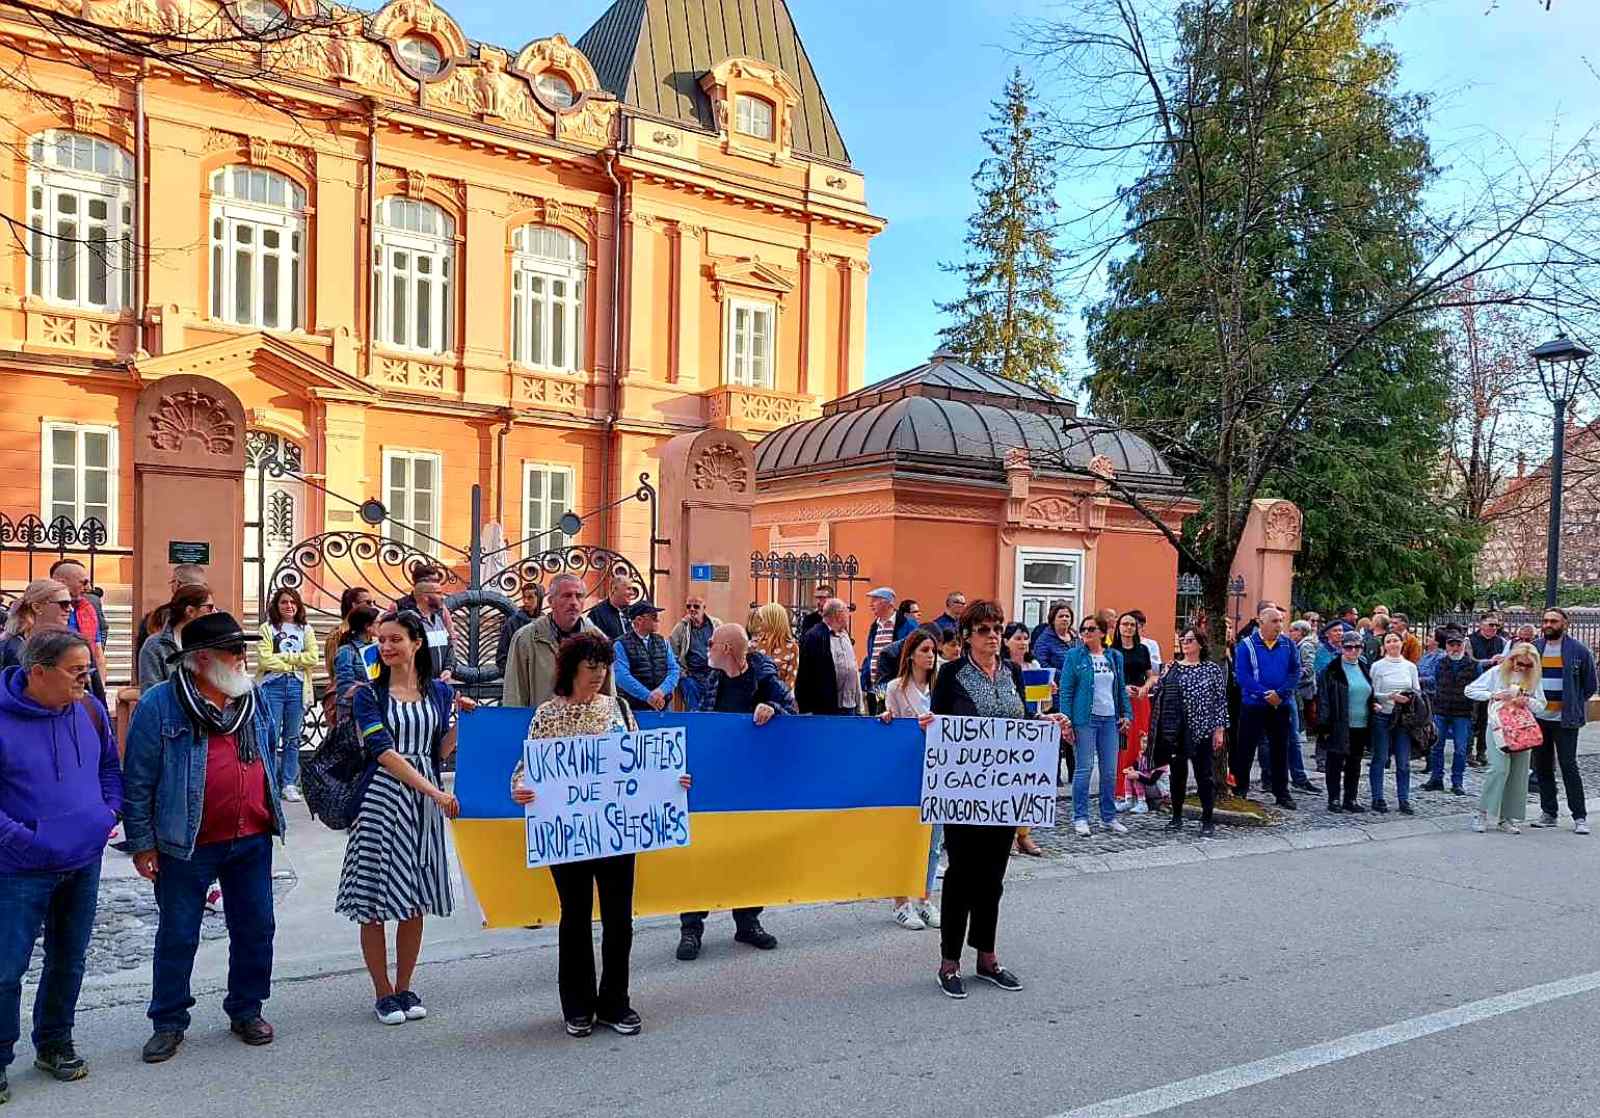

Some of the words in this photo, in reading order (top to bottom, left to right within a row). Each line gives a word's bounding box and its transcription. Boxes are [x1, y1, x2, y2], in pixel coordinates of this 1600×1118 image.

[619, 731, 684, 773] SUFFERS
[926, 747, 948, 769] SU
[956, 747, 1035, 768] DUBOKO
[567, 782, 601, 805] DUE
[614, 778, 638, 796] TO
[927, 773, 938, 790] U
[527, 812, 601, 864] EUROPEAN
[604, 801, 688, 851] SELFISHNESS
